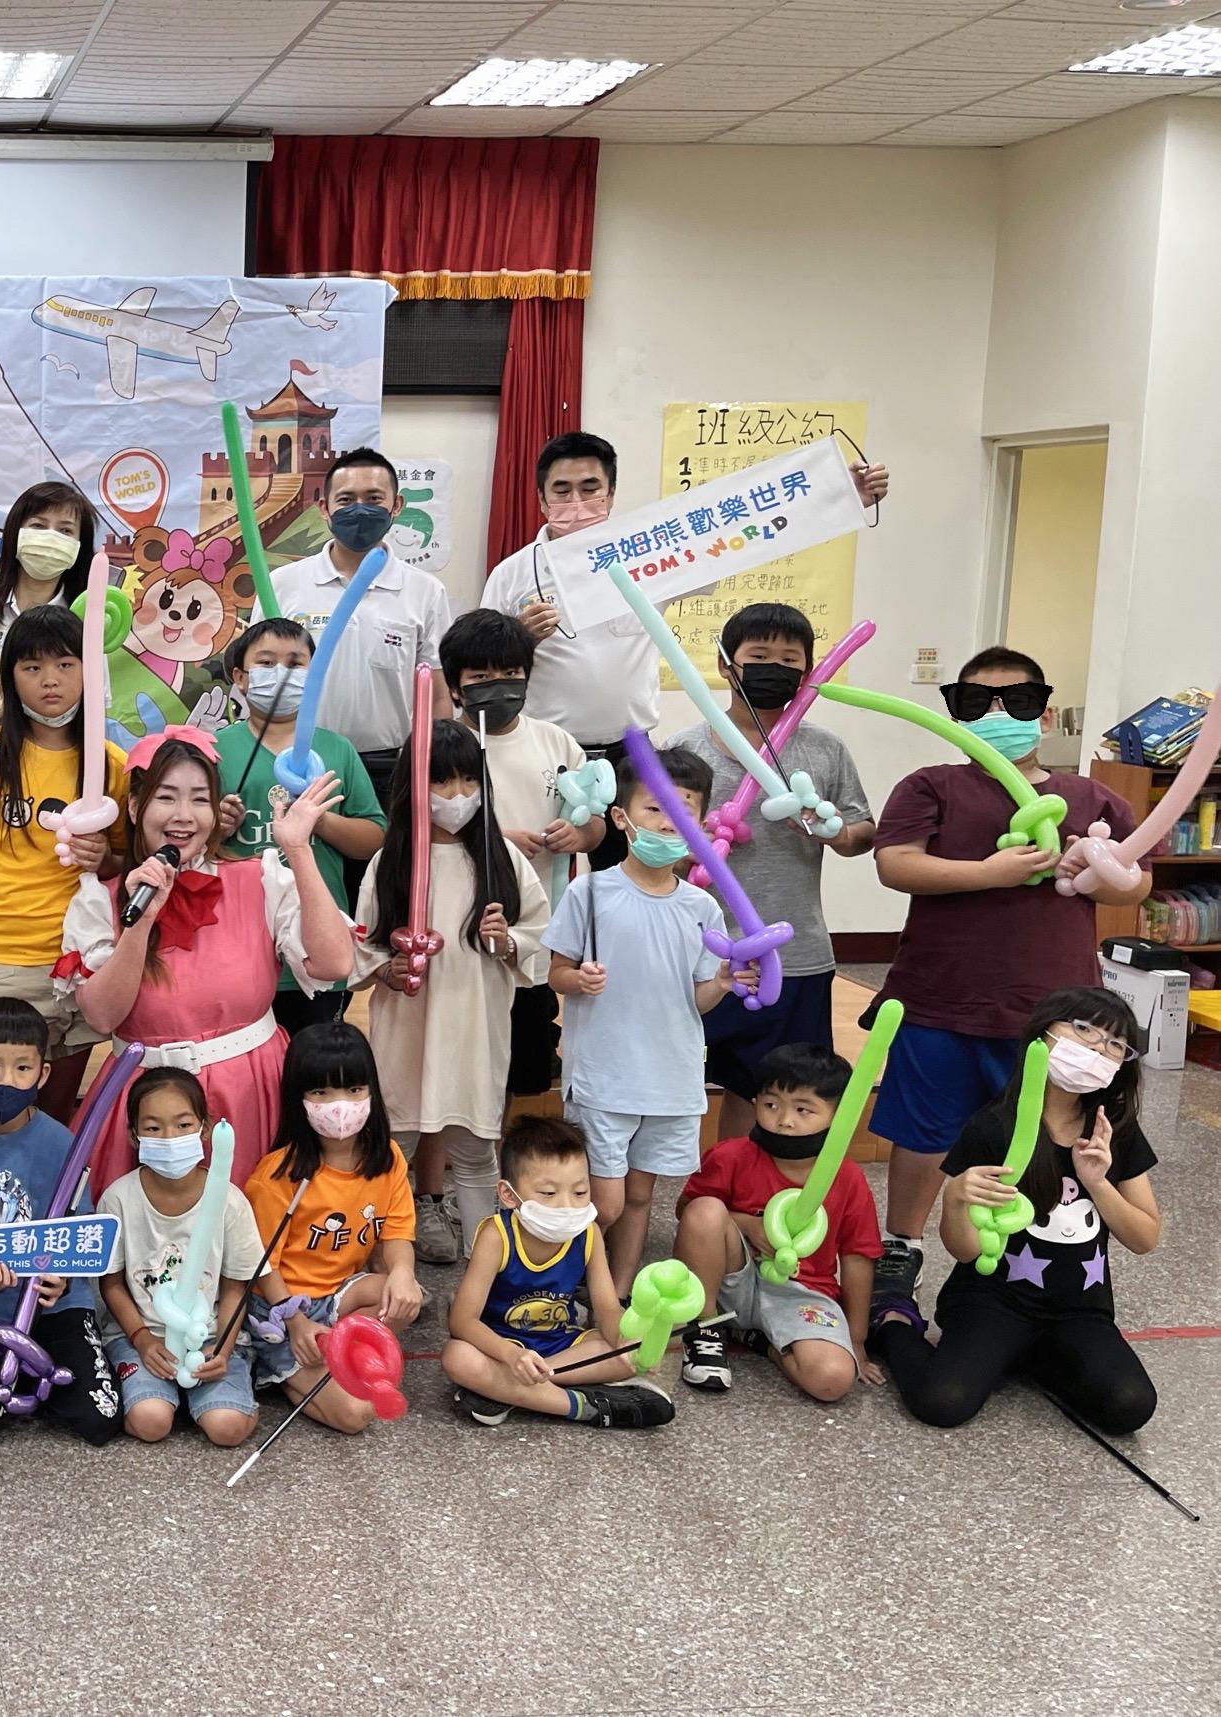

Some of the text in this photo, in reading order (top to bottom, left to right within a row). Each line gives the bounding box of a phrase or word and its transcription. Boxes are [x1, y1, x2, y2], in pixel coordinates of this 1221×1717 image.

[695, 408, 835, 446] 班級公約
[115, 470, 151, 487] TOM'S
[115, 481, 156, 499] WORLD
[587, 470, 812, 573] 湯姆熊歡樂世界
[706, 516, 788, 558] WORLD
[7, 1260, 31, 1268] THIS
[72, 1259, 102, 1267] MUCH
[512, 1290, 556, 1305] GOLDEN
[700, 1329, 720, 1339] FILA
